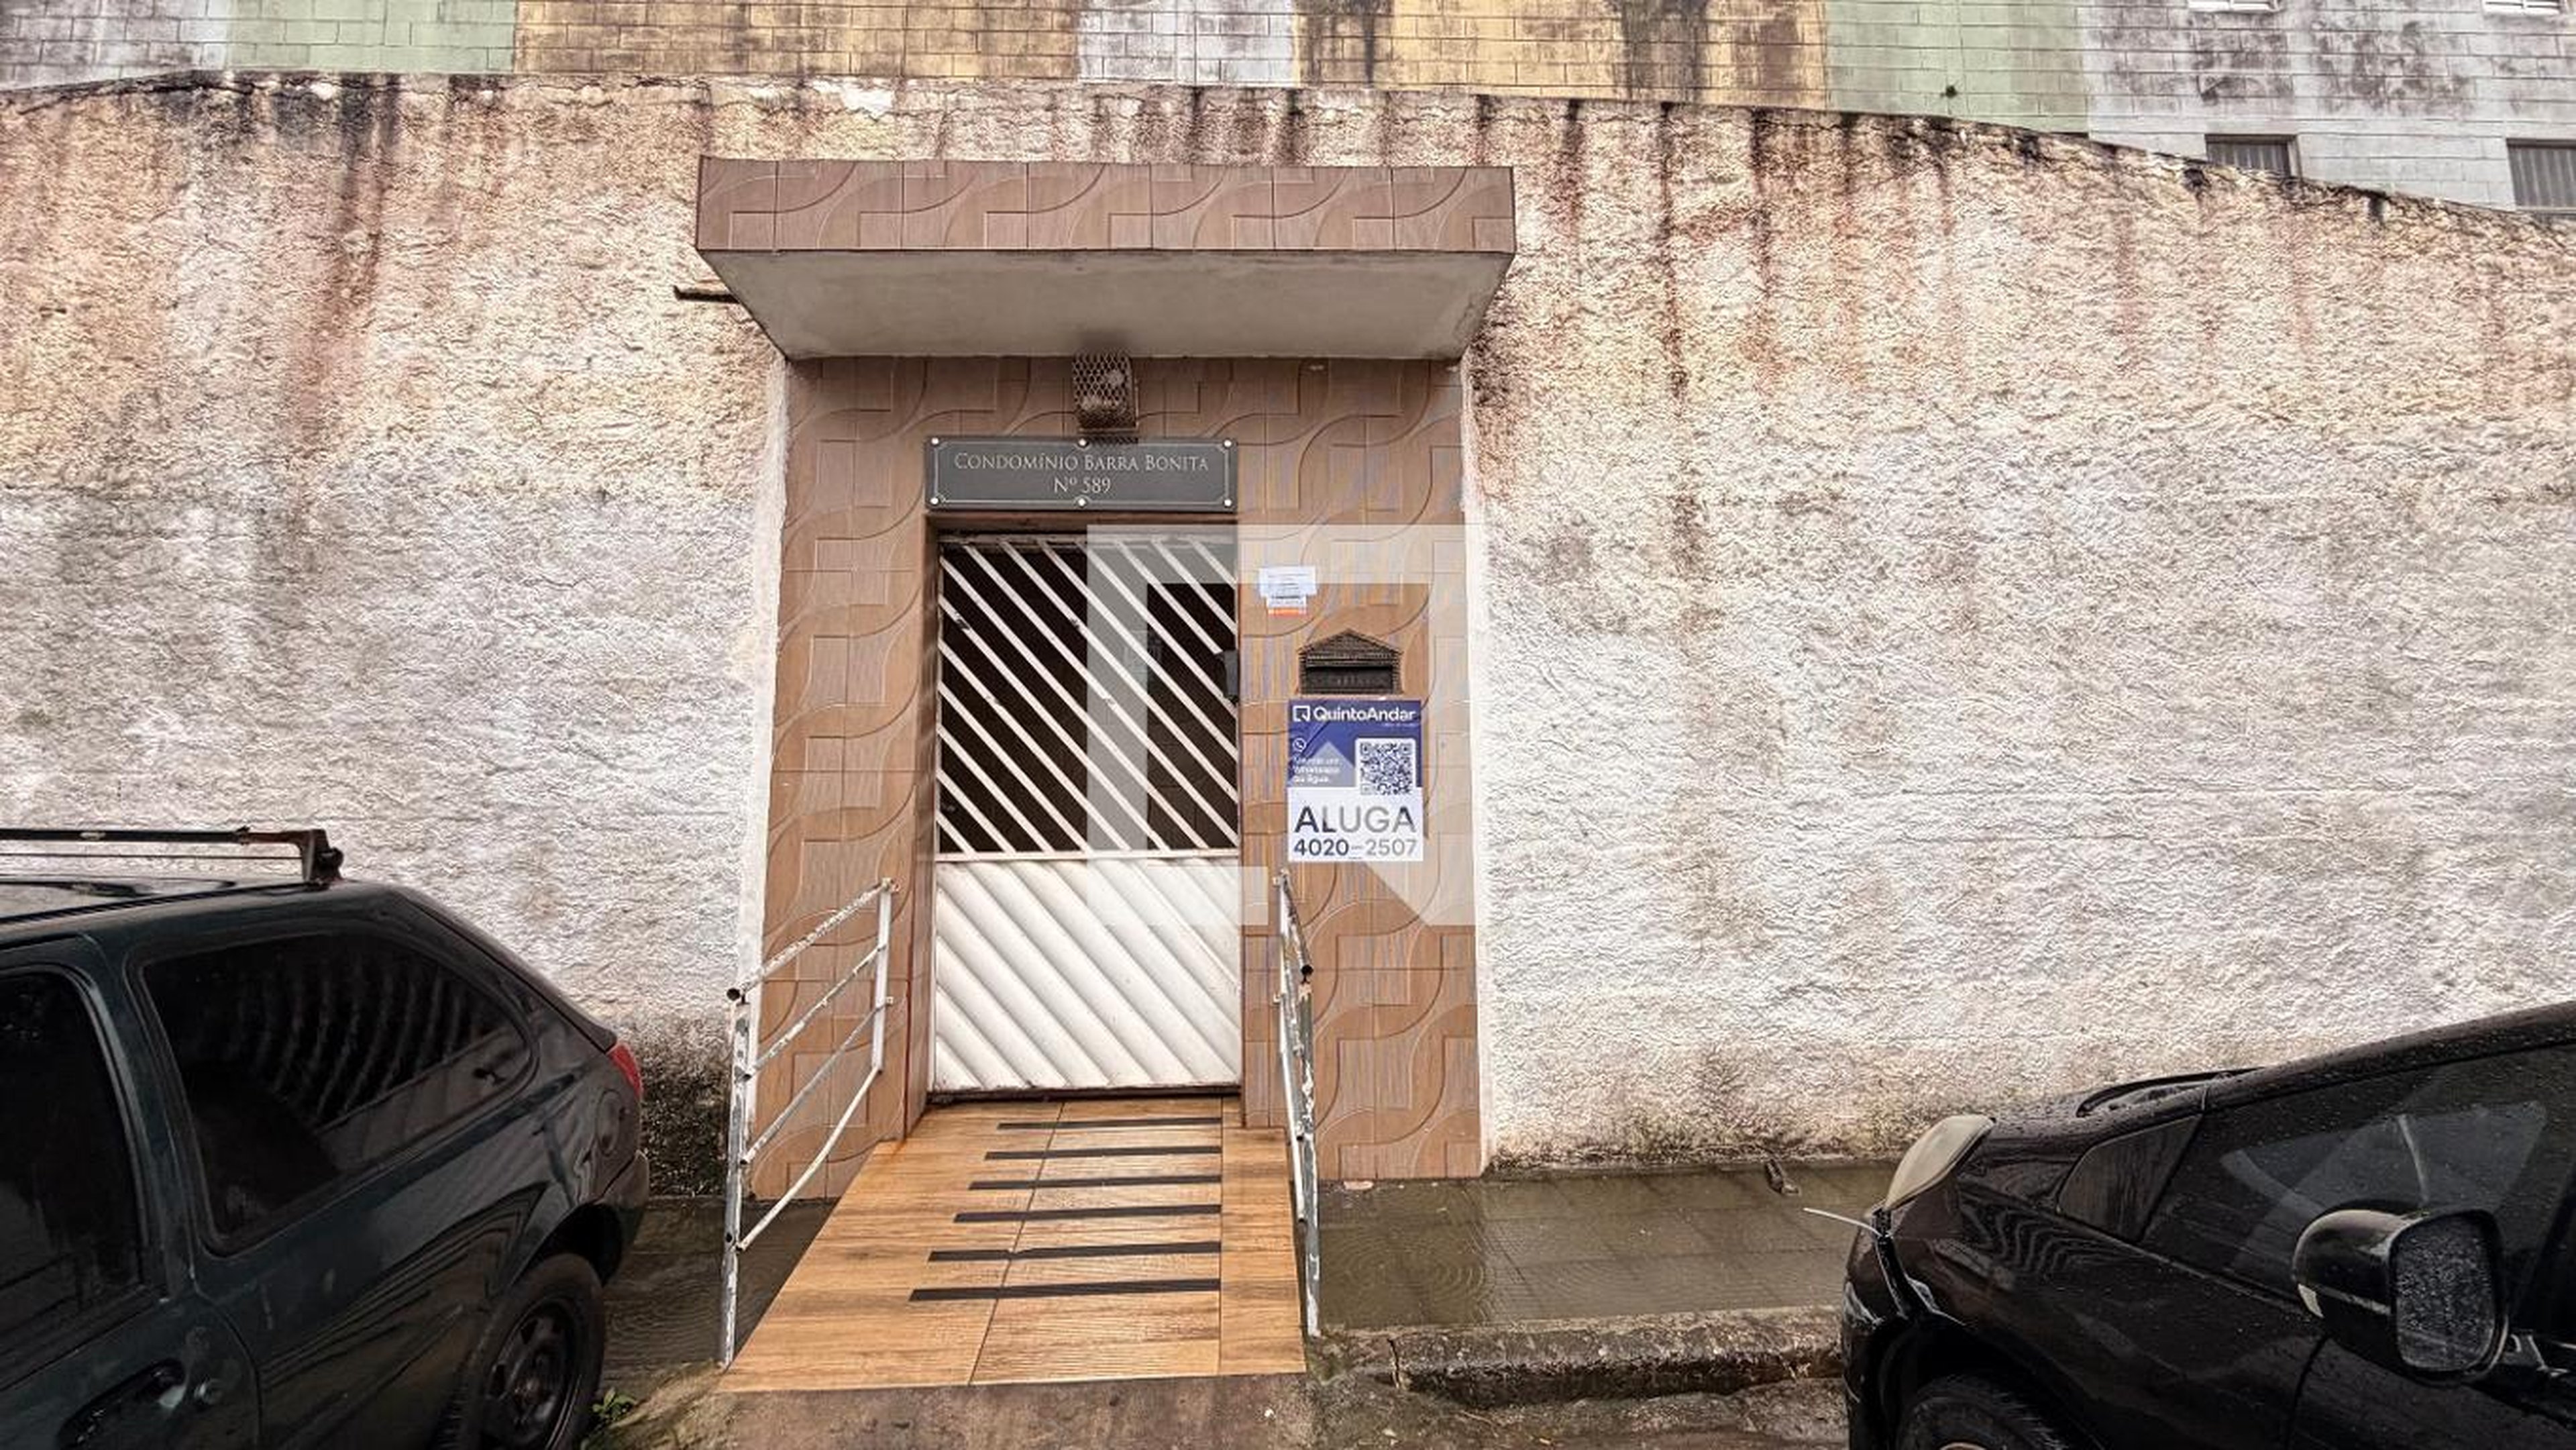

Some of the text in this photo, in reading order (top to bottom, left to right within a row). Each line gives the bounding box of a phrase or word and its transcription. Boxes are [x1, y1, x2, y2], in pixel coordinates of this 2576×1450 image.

[1084, 454, 1139, 470] BARRA
[1145, 454, 1208, 470] BONITA
[1082, 476, 1111, 493] 589
[1313, 706, 1416, 721] QuintoAndar
[1294, 806, 1417, 833] ALUGA
[1294, 838, 1417, 856] 4020-2507
